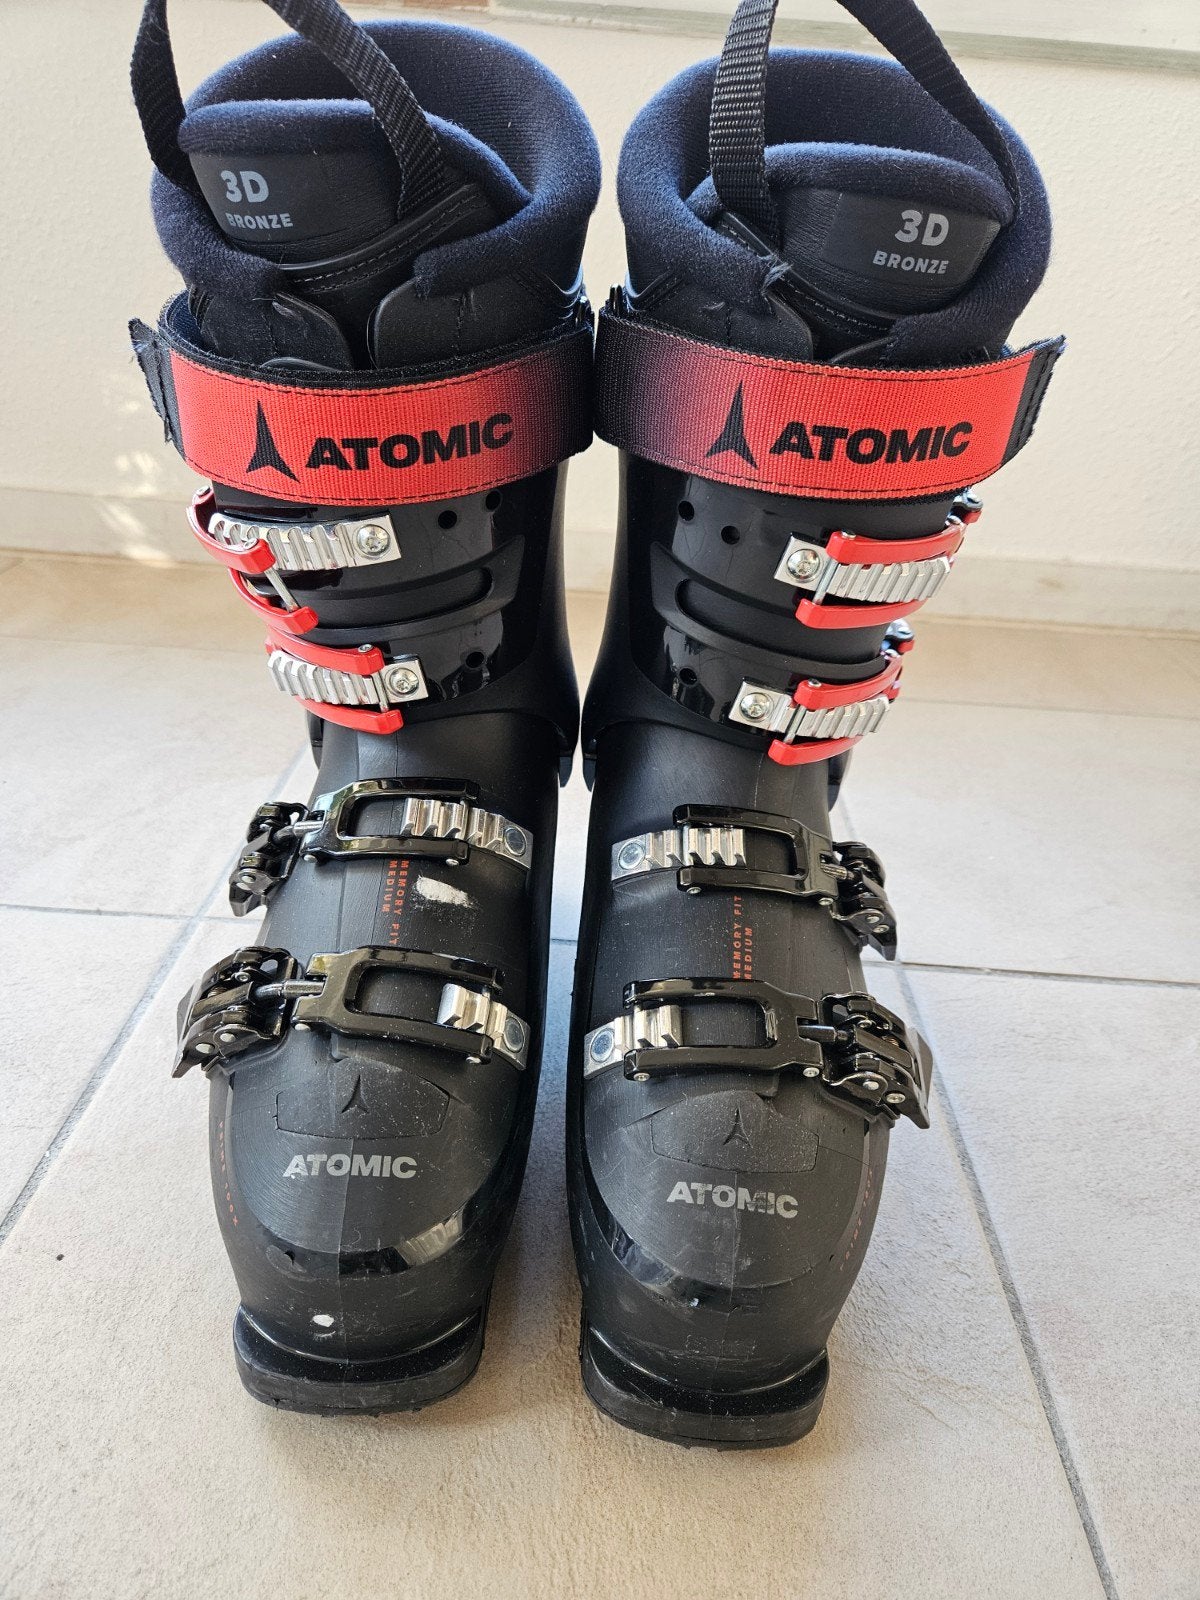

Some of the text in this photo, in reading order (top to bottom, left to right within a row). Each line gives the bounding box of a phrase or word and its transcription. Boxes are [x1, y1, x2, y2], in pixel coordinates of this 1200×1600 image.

[220, 170, 269, 203] 3D
[225, 212, 294, 230] BRONZE
[894, 209, 950, 247] 3D
[872, 250, 950, 275] BRONZE
[304, 413, 514, 472] ATOMIC
[769, 421, 974, 465] ATOMIC
[381, 859, 398, 913] MEDIUM
[388, 859, 410, 946] MEMORY FIT
[732, 895, 742, 980] MEMORY FIT
[743, 926, 753, 980] MEDIUM
[282, 1153, 418, 1179] ATOMIC
[666, 1181, 799, 1219] ATOMIC
